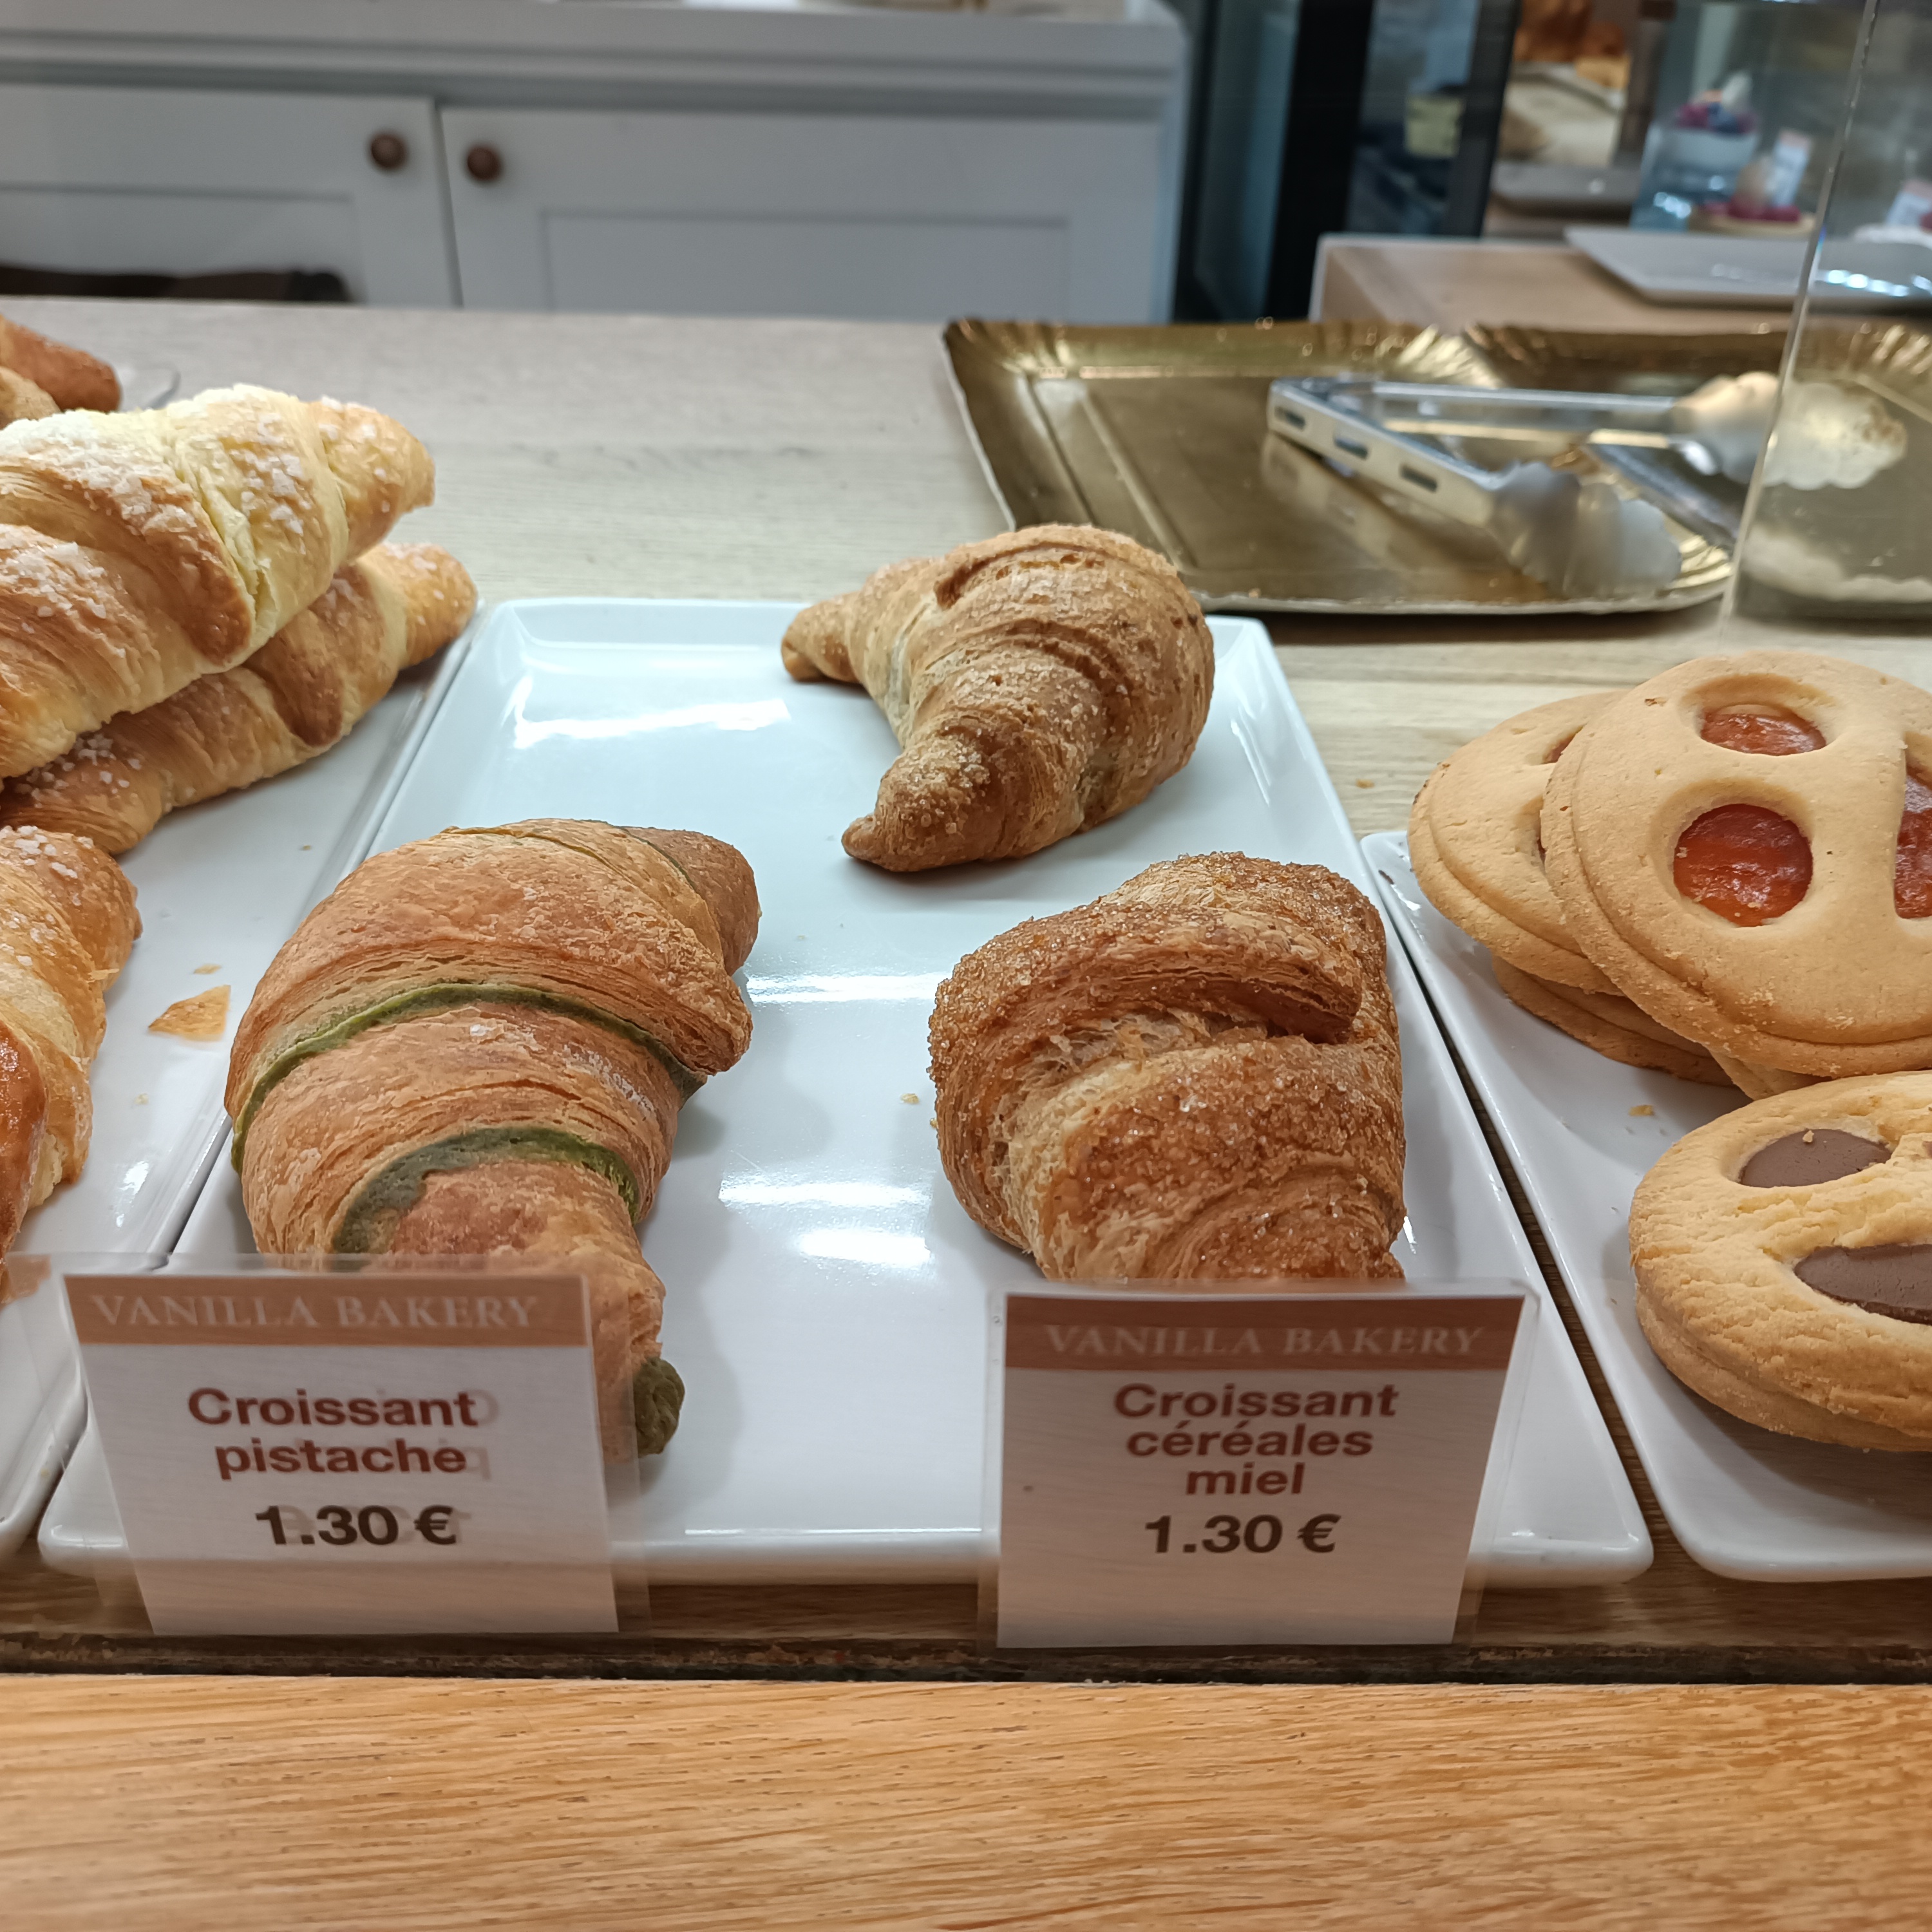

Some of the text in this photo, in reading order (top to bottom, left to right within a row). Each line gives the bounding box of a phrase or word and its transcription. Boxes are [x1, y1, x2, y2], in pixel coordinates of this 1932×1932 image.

[90, 1294, 538, 1329] VANILLA BAKERY
[1043, 1325, 1484, 1356] VANILLA BAKERY
[187, 1388, 479, 1427] Croissant
[1113, 1383, 1399, 1417] Croissant
[1125, 1419, 1374, 1457] céréales
[214, 1438, 467, 1481] pistache
[1185, 1463, 1305, 1495] miel
[254, 1505, 458, 1546] 1.30 €
[1144, 1513, 1342, 1554] 1.30 €
